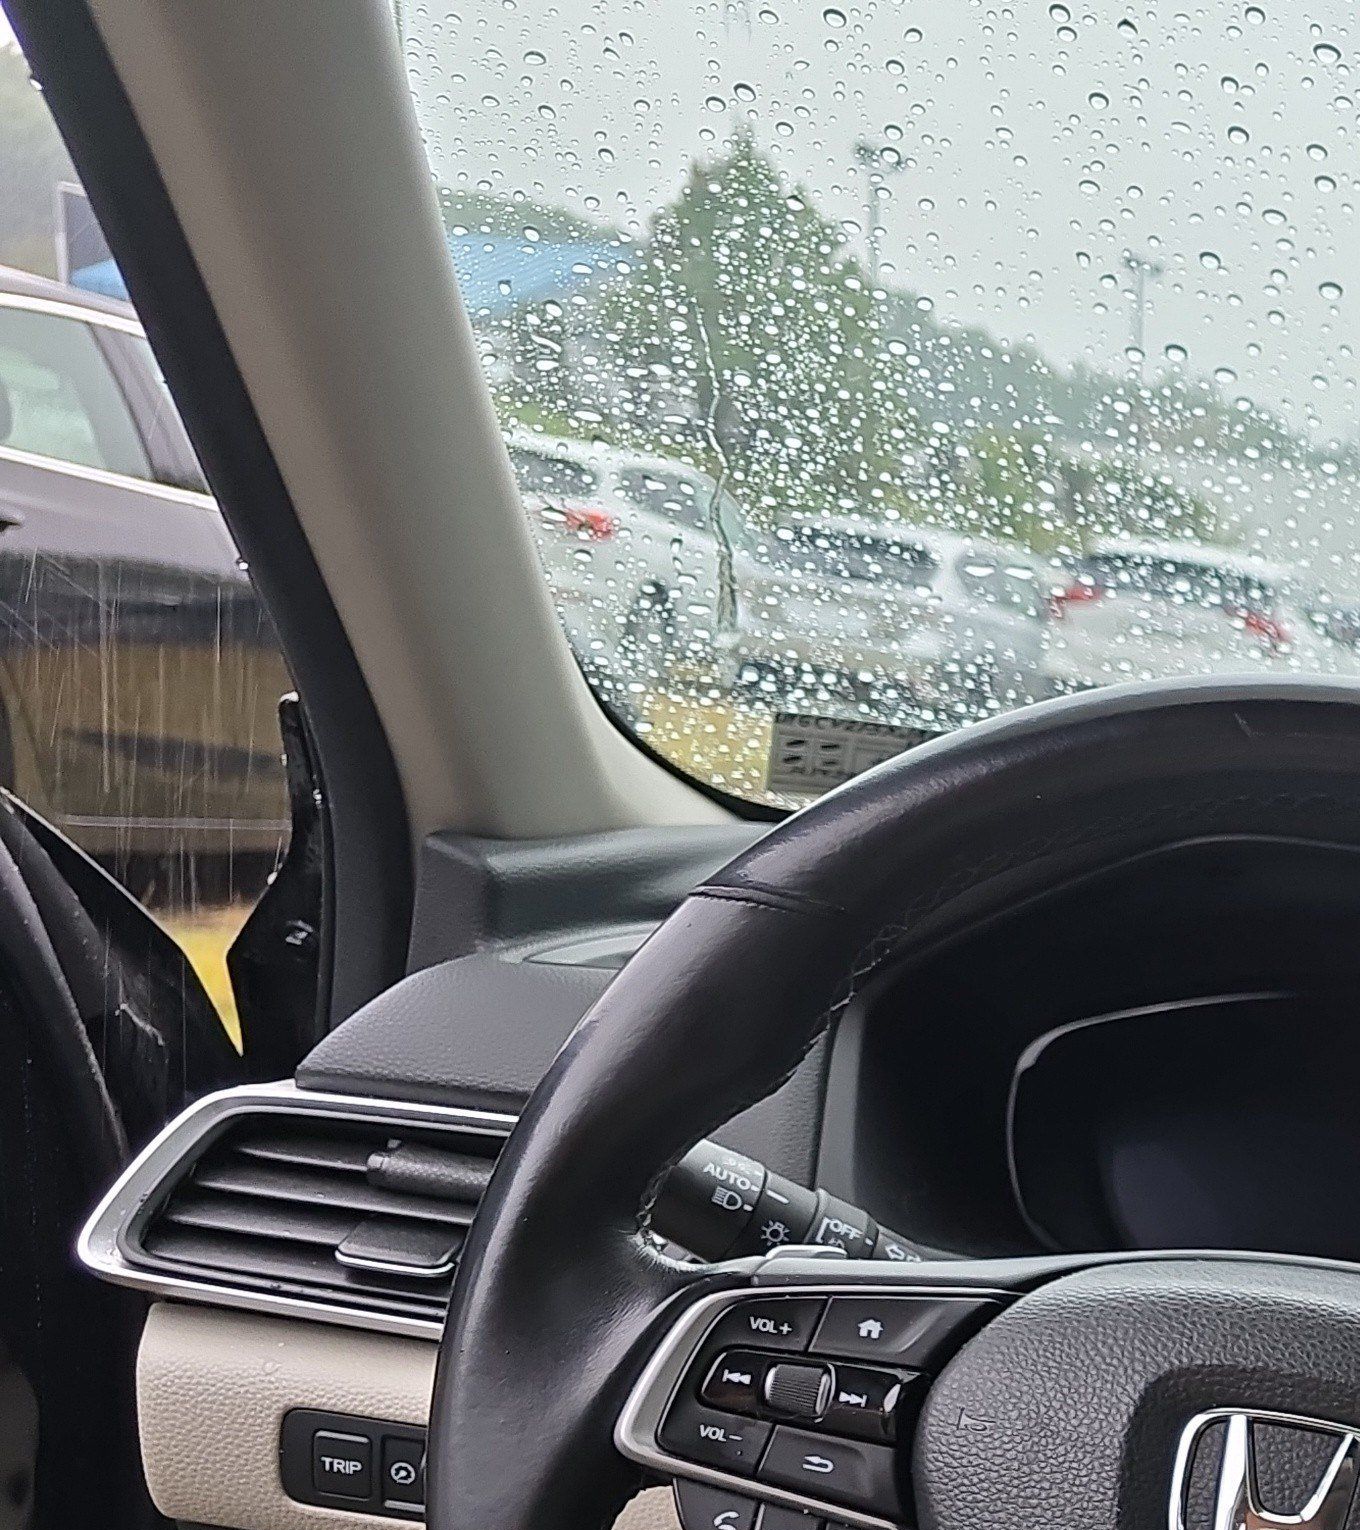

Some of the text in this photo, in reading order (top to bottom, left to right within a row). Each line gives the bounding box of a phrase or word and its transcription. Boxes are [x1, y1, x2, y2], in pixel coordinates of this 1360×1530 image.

[703, 1162, 751, 1191] AUTO
[828, 1218, 864, 1240] OFF
[320, 1455, 363, 1476] TRIP
